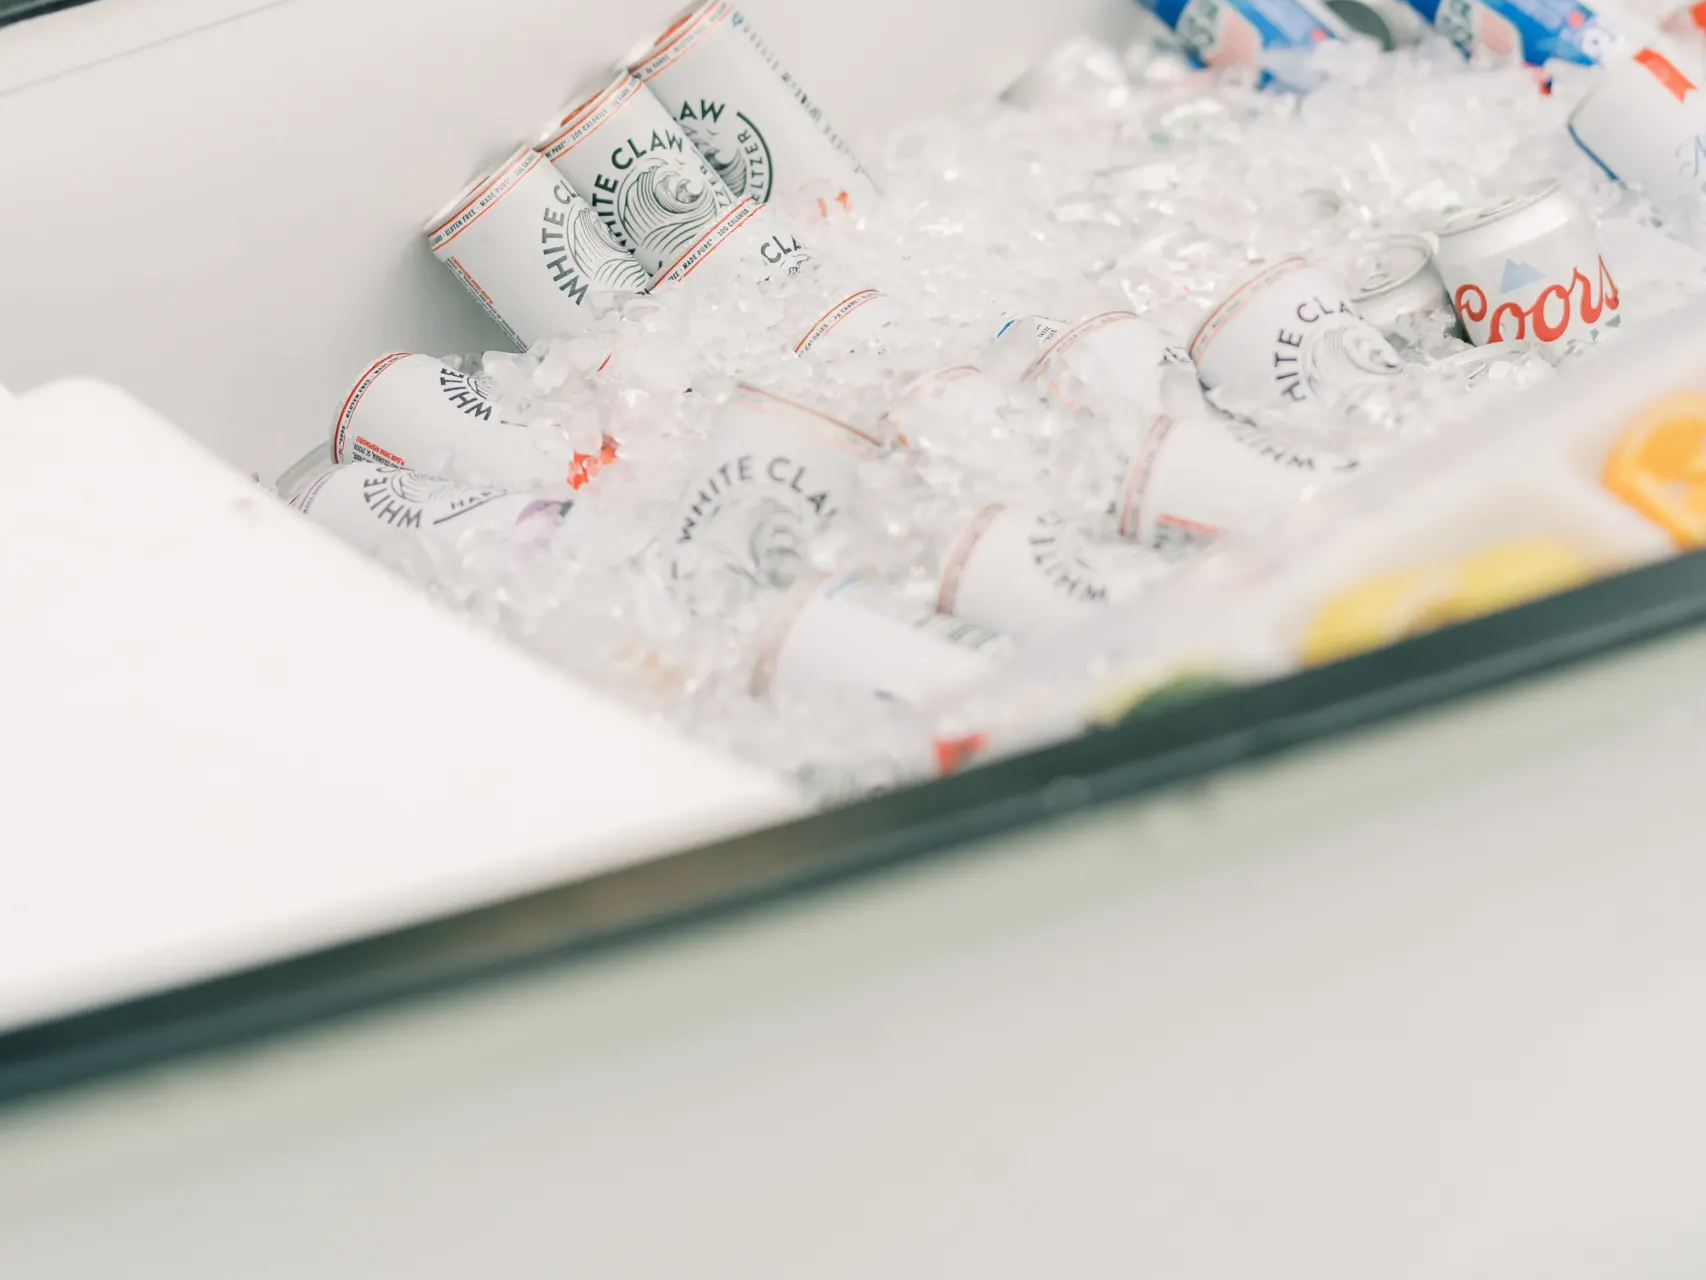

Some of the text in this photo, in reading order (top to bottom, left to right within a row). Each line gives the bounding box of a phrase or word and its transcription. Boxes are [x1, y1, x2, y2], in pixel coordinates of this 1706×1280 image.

[673, 99, 726, 123] AW
[611, 129, 683, 170] CLAW
[736, 129, 764, 205] ELTZER
[461, 208, 477, 223] FREE
[479, 191, 497, 207] MADE
[541, 180, 589, 306] WHITE CL
[682, 255, 698, 270] MADE
[760, 234, 802, 263] CLA
[1454, 253, 1620, 344] Coors
[1274, 296, 1352, 403] HITE CLA
[363, 476, 423, 528] WHITE
[677, 455, 838, 544] WHITE CLA
